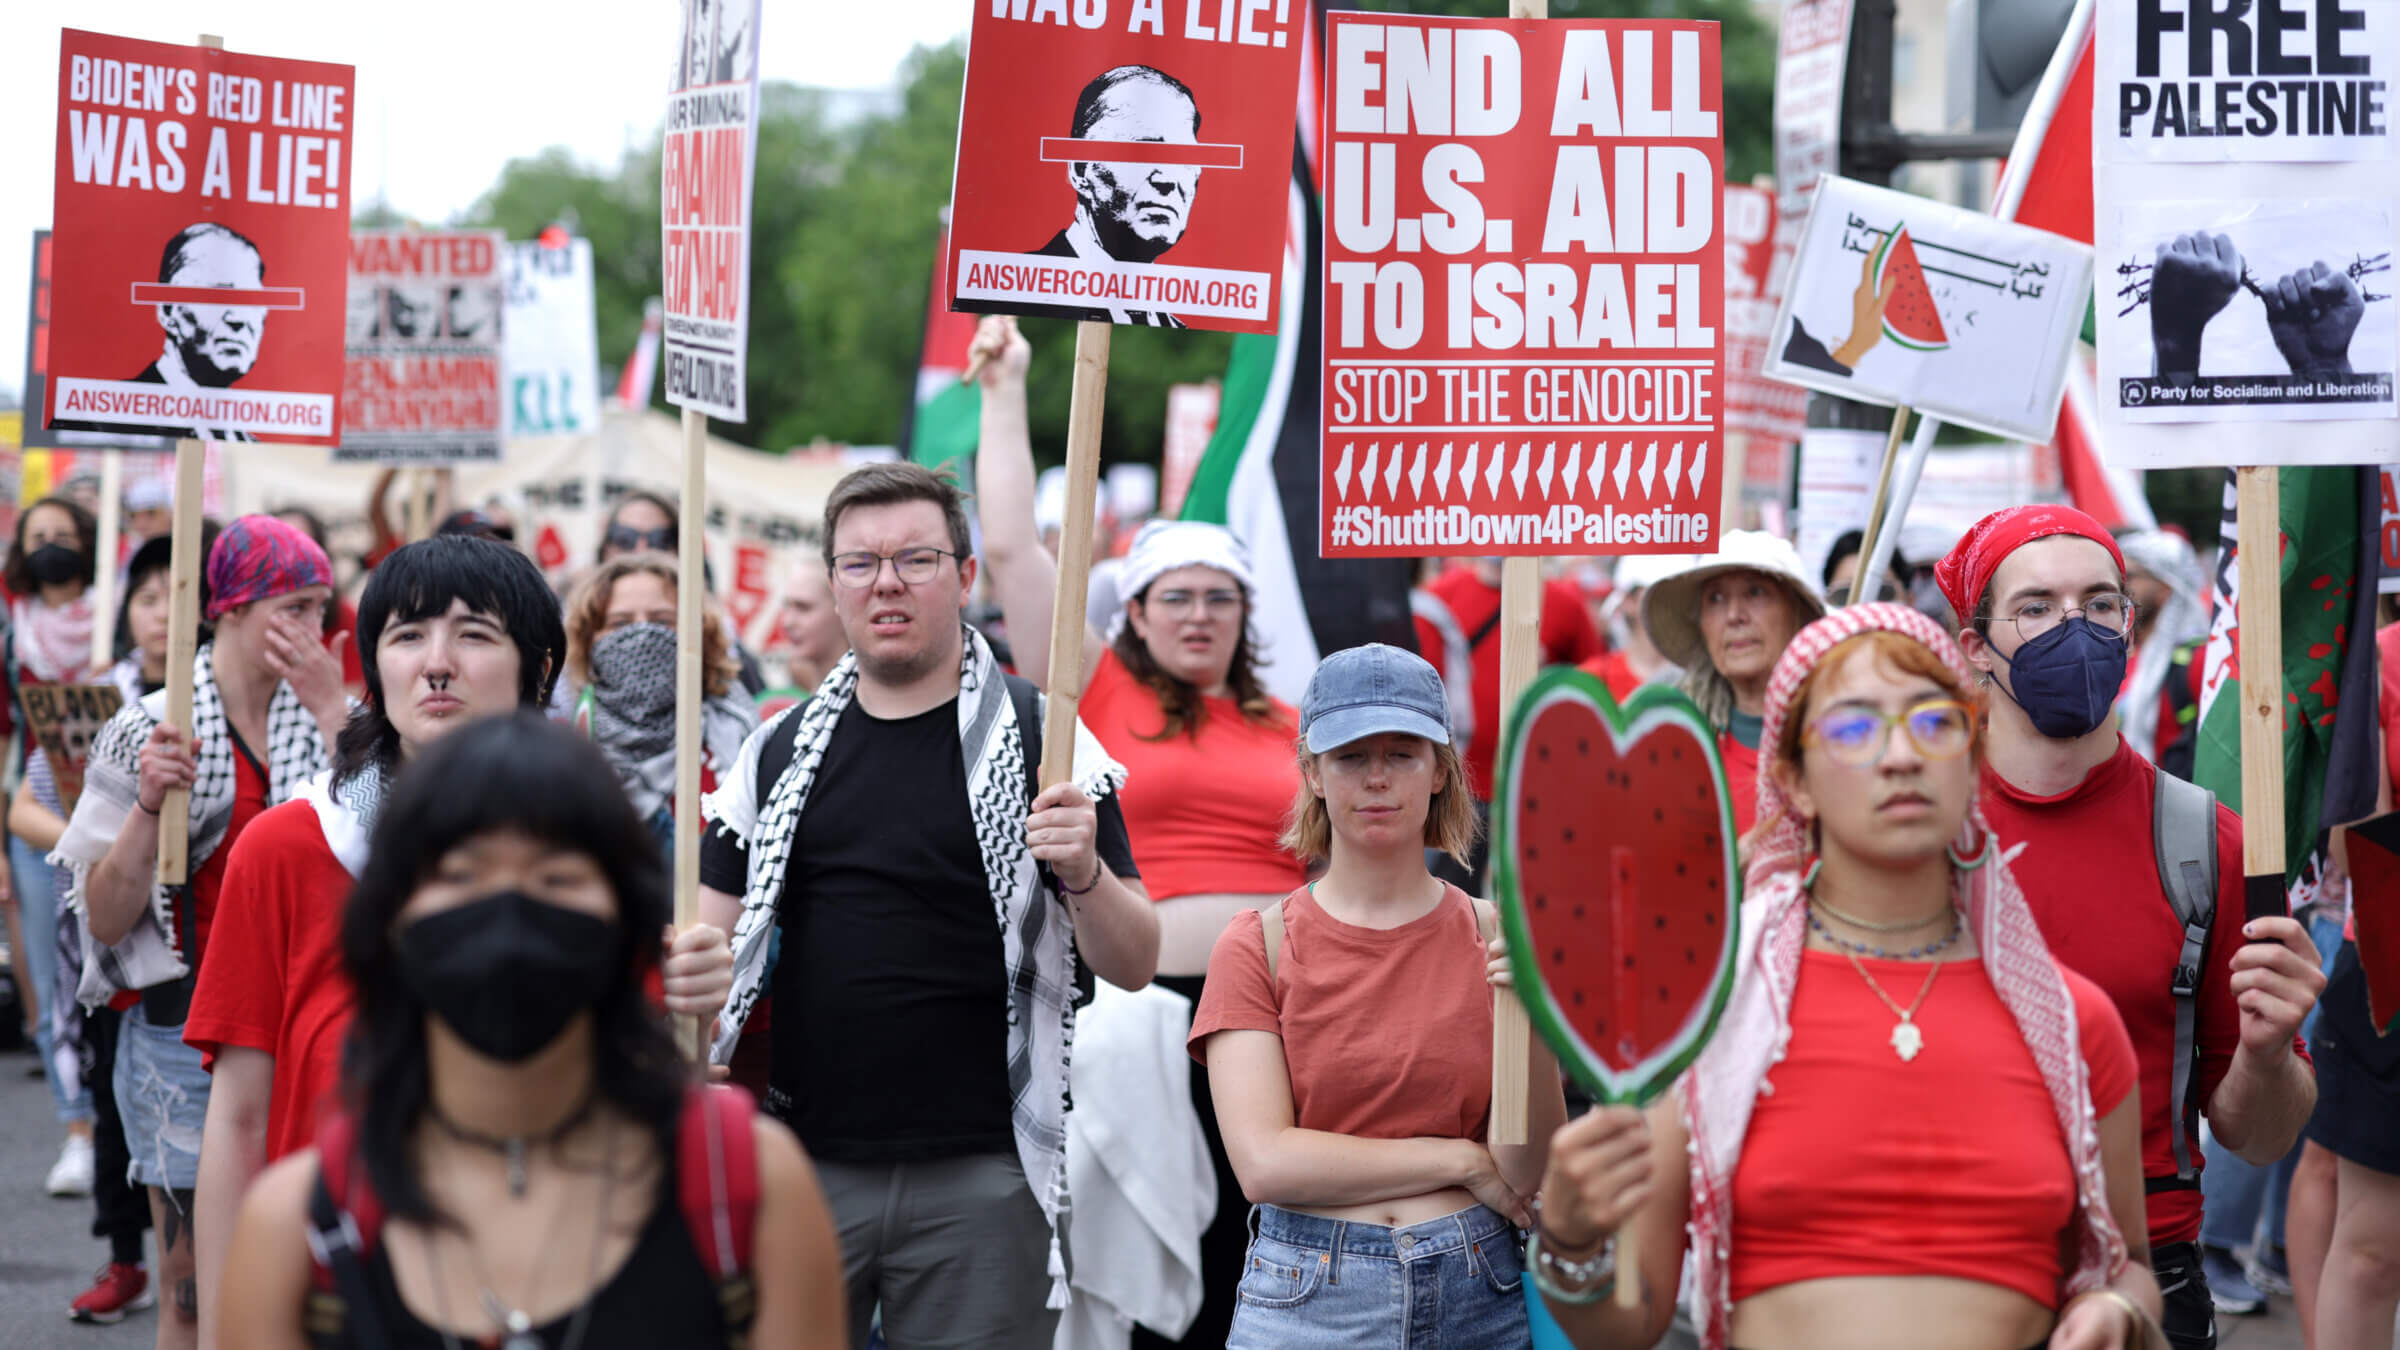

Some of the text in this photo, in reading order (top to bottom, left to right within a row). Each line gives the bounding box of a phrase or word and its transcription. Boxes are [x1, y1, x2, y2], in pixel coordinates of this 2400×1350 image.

[2136, 0, 2371, 77] FREE
[69, 54, 345, 131] BIDEN'S RED LINE
[1335, 23, 1522, 137] END
[1550, 29, 1718, 138] ALL
[2119, 81, 2386, 137] PALESTINE
[69, 109, 341, 209] WAS A LIE!
[1333, 141, 1513, 255] U.S.
[1541, 145, 1713, 254] AID
[966, 263, 1258, 310] ANSWERCOALITION.ORG
[1330, 261, 1425, 350] TO
[1447, 261, 1716, 350] ISRAEL
[65, 389, 322, 426] ANSWERCOALITION.ORG
[1334, 368, 1427, 424] STOP
[1437, 368, 1510, 424] THE
[1523, 368, 1714, 424] GENOCIDE
[2151, 386, 2188, 402] Party
[2191, 385, 2210, 398] for
[2213, 384, 2282, 398] Socialism
[2286, 383, 2313, 396] and
[2317, 382, 2389, 396] Liberation
[1331, 505, 1709, 547] #ShutItDown4Palestine
